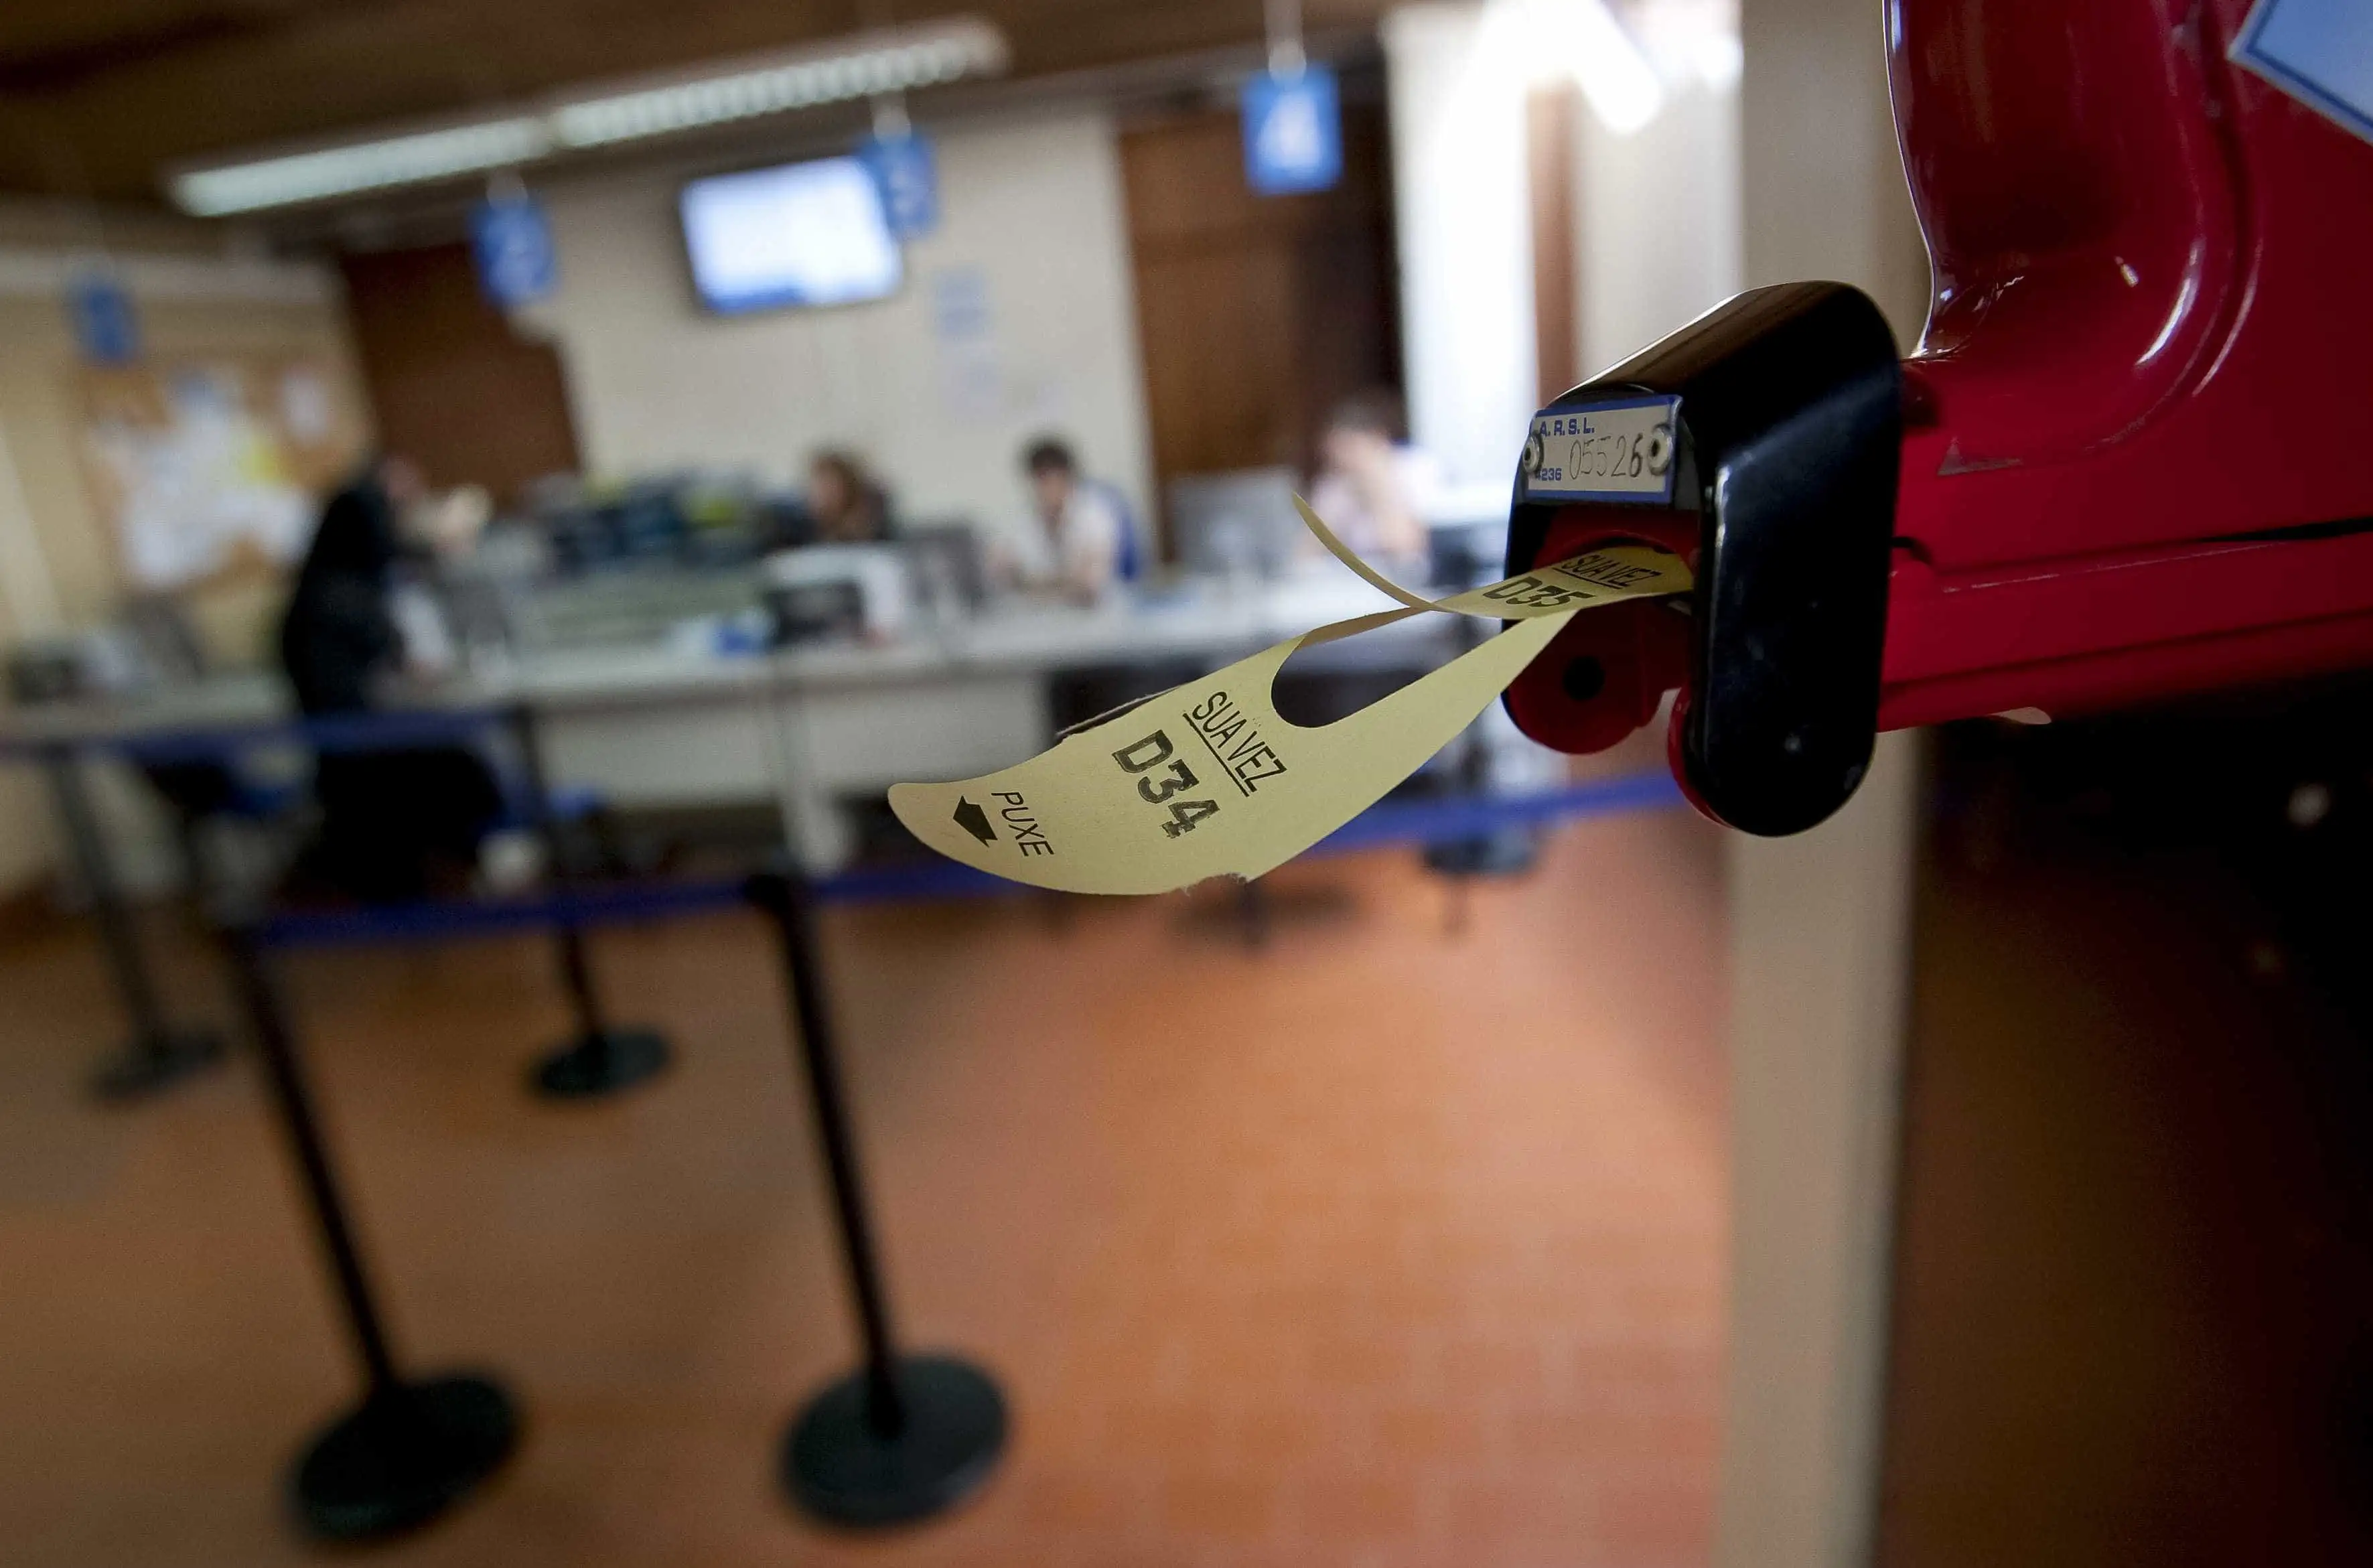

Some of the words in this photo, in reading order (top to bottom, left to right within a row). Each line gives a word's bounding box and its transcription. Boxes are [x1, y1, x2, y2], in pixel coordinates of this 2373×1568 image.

[1570, 433, 1643, 480] 05526
[1482, 576, 1596, 608] D35
[1112, 729, 1221, 839] D34
[991, 792, 1054, 856] PUXE
